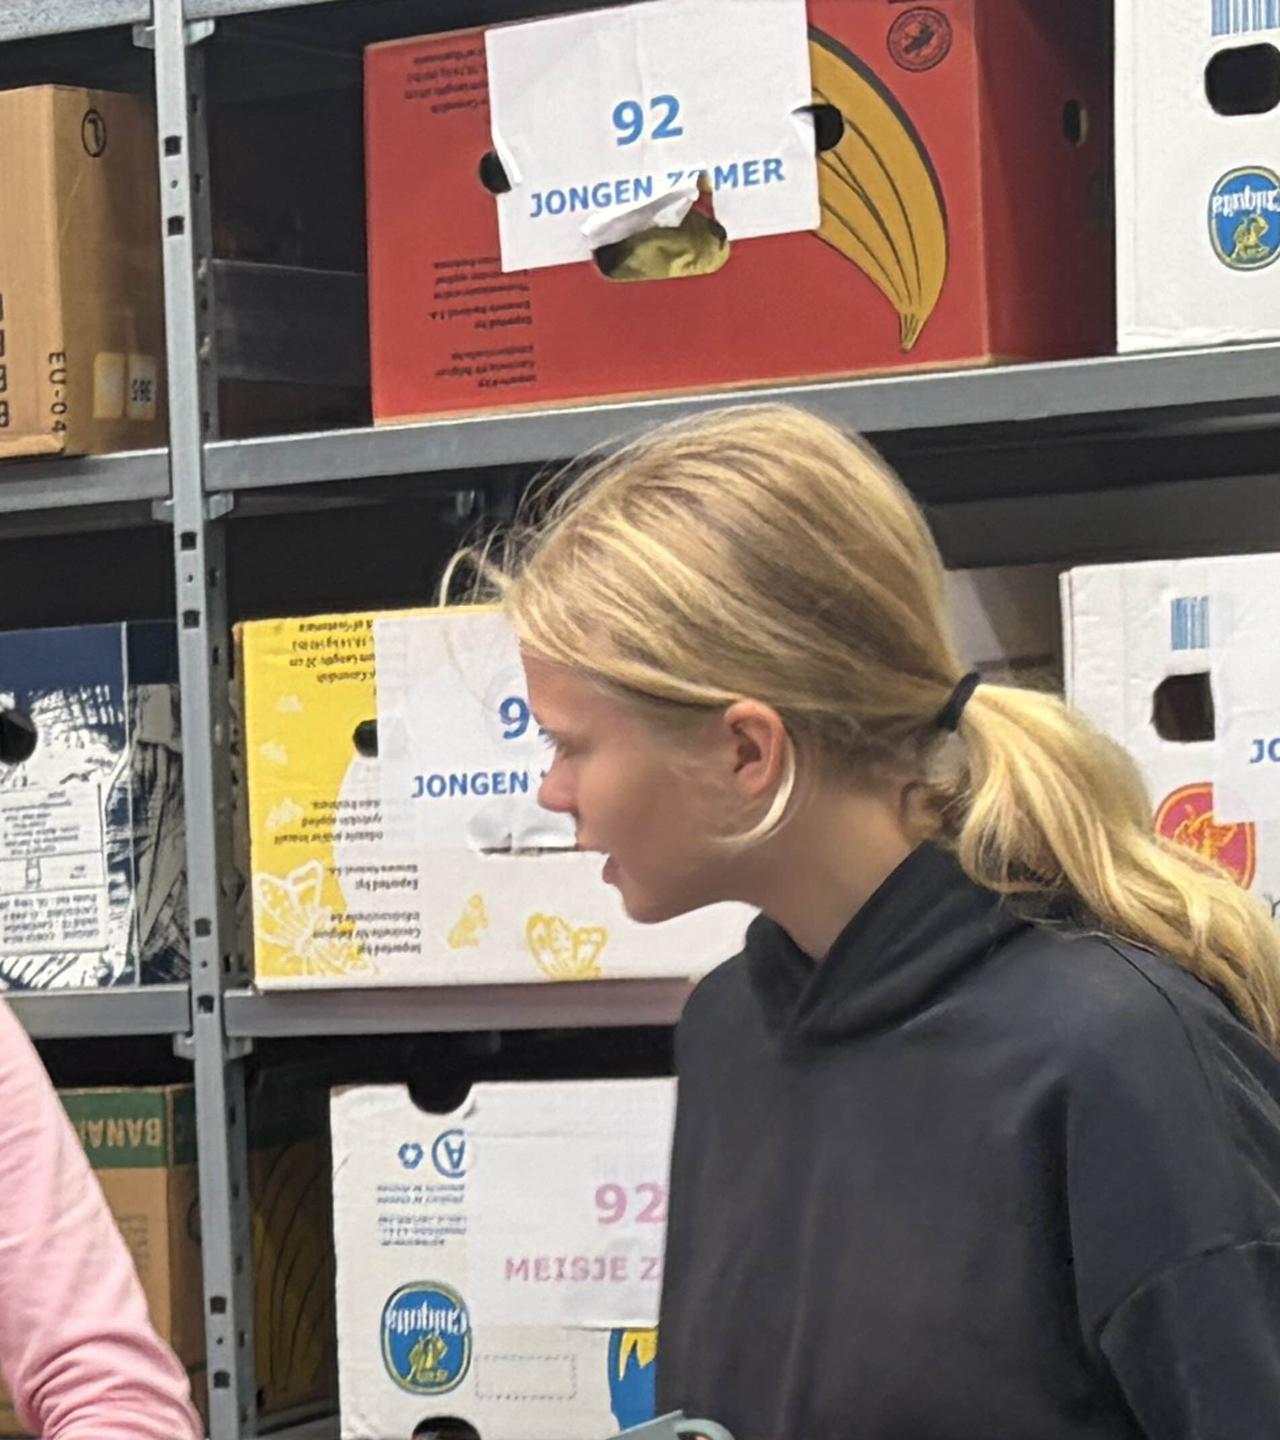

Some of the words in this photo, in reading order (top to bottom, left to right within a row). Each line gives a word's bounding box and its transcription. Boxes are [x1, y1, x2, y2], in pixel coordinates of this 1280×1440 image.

[612, 95, 683, 146] 92
[529, 176, 653, 218] JONGEN
[667, 158, 786, 191] ZMER
[498, 696, 531, 740] 9
[412, 771, 529, 799] JONGEN
[593, 1183, 667, 1224] 92
[504, 1256, 628, 1283] MEISJE
